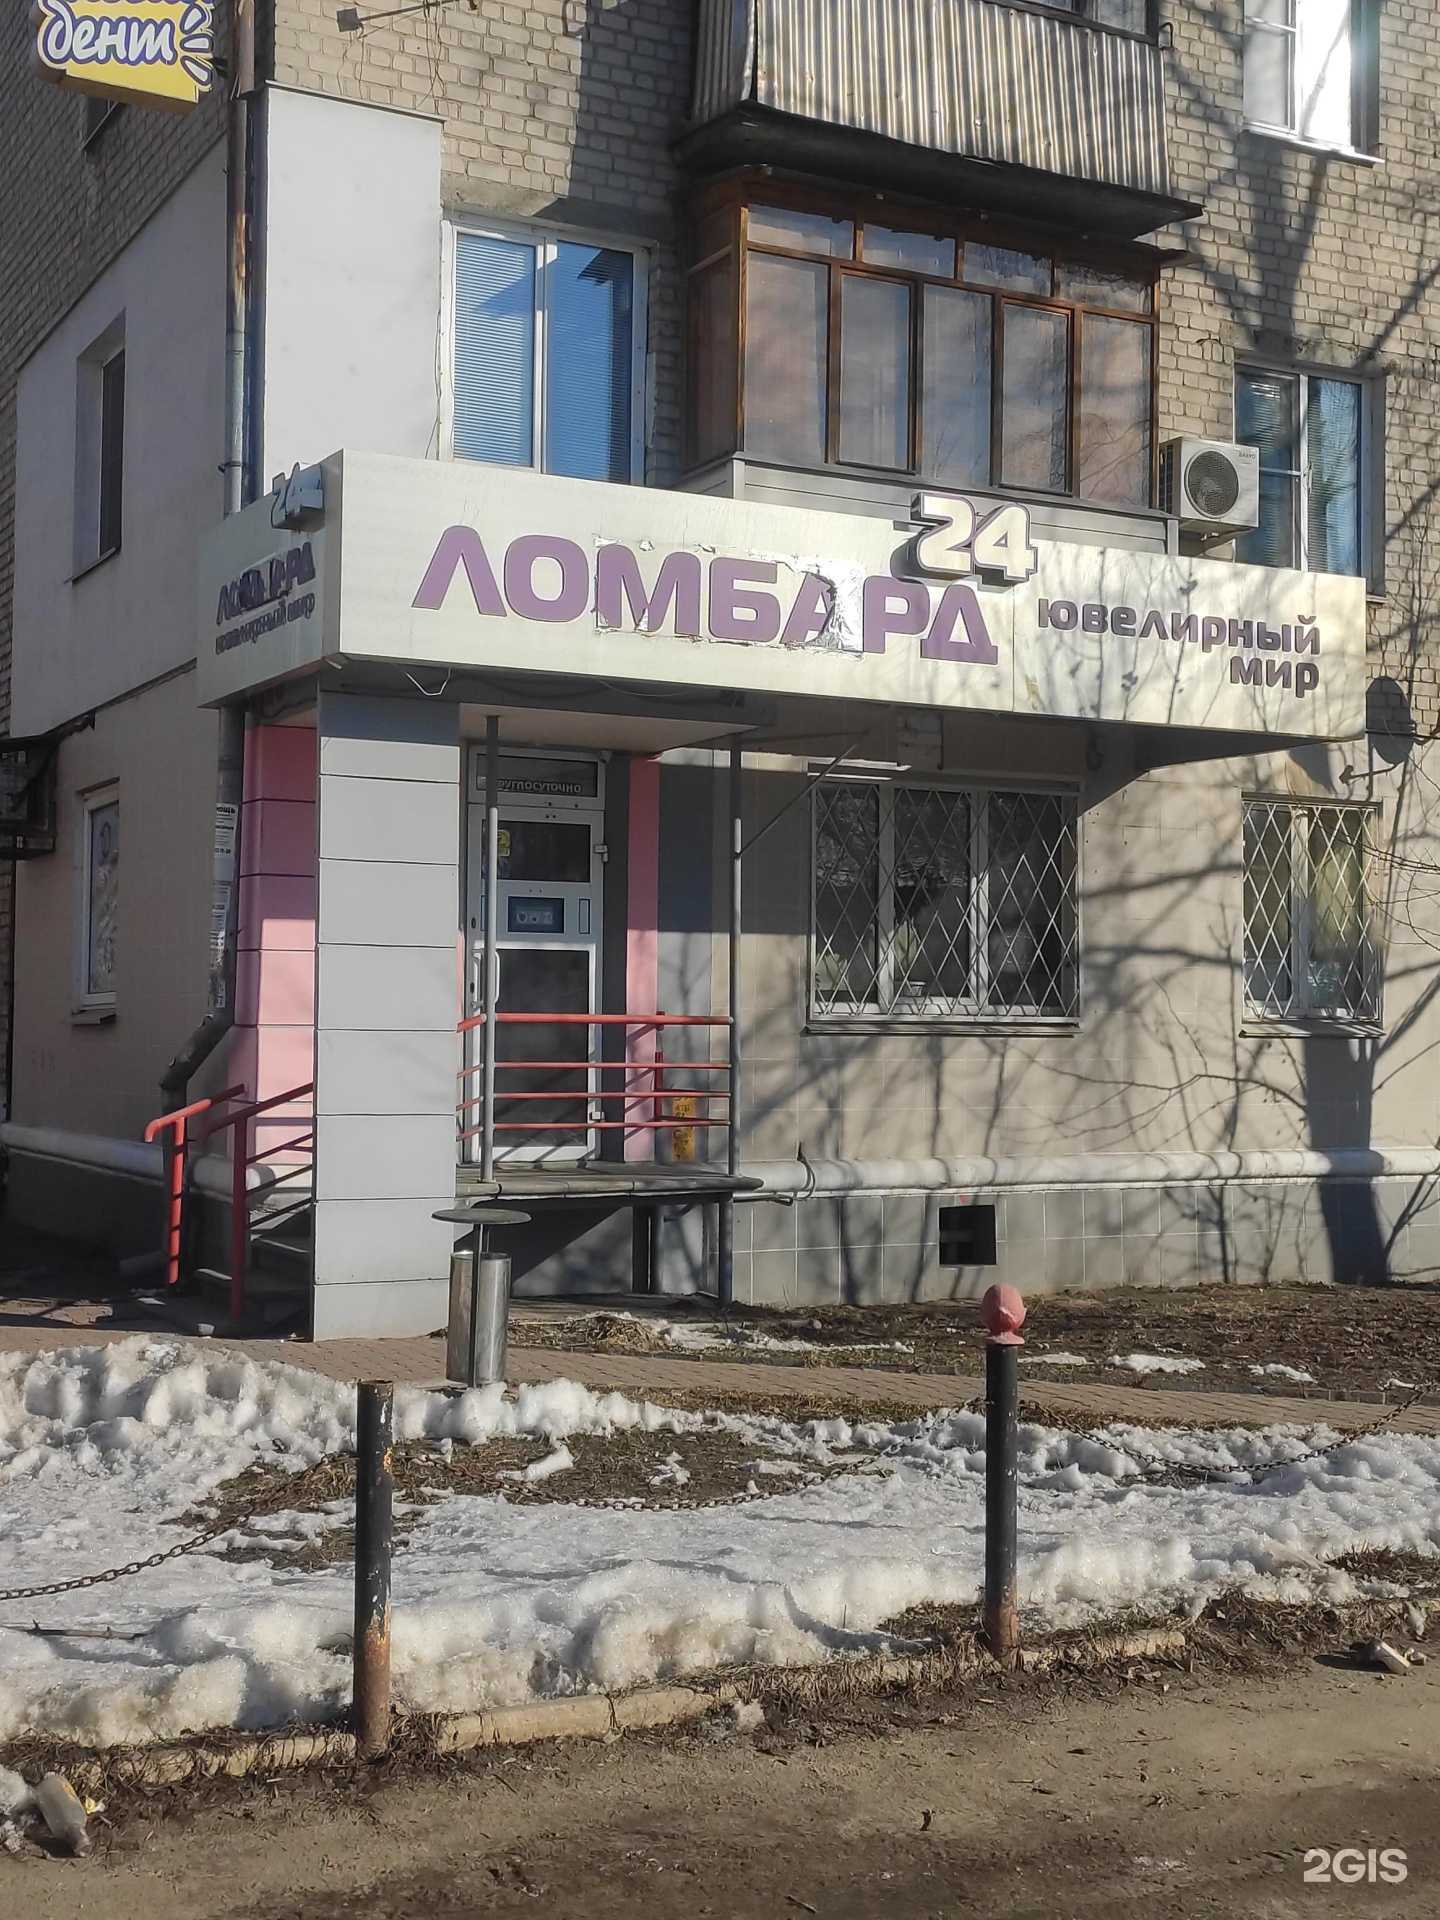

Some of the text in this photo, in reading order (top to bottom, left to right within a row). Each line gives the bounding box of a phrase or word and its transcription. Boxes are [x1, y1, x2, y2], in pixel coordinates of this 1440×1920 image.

[44, 0, 177, 63] дент
[918, 492, 1038, 583] 24
[411, 524, 999, 666] ЛОМБАРД
